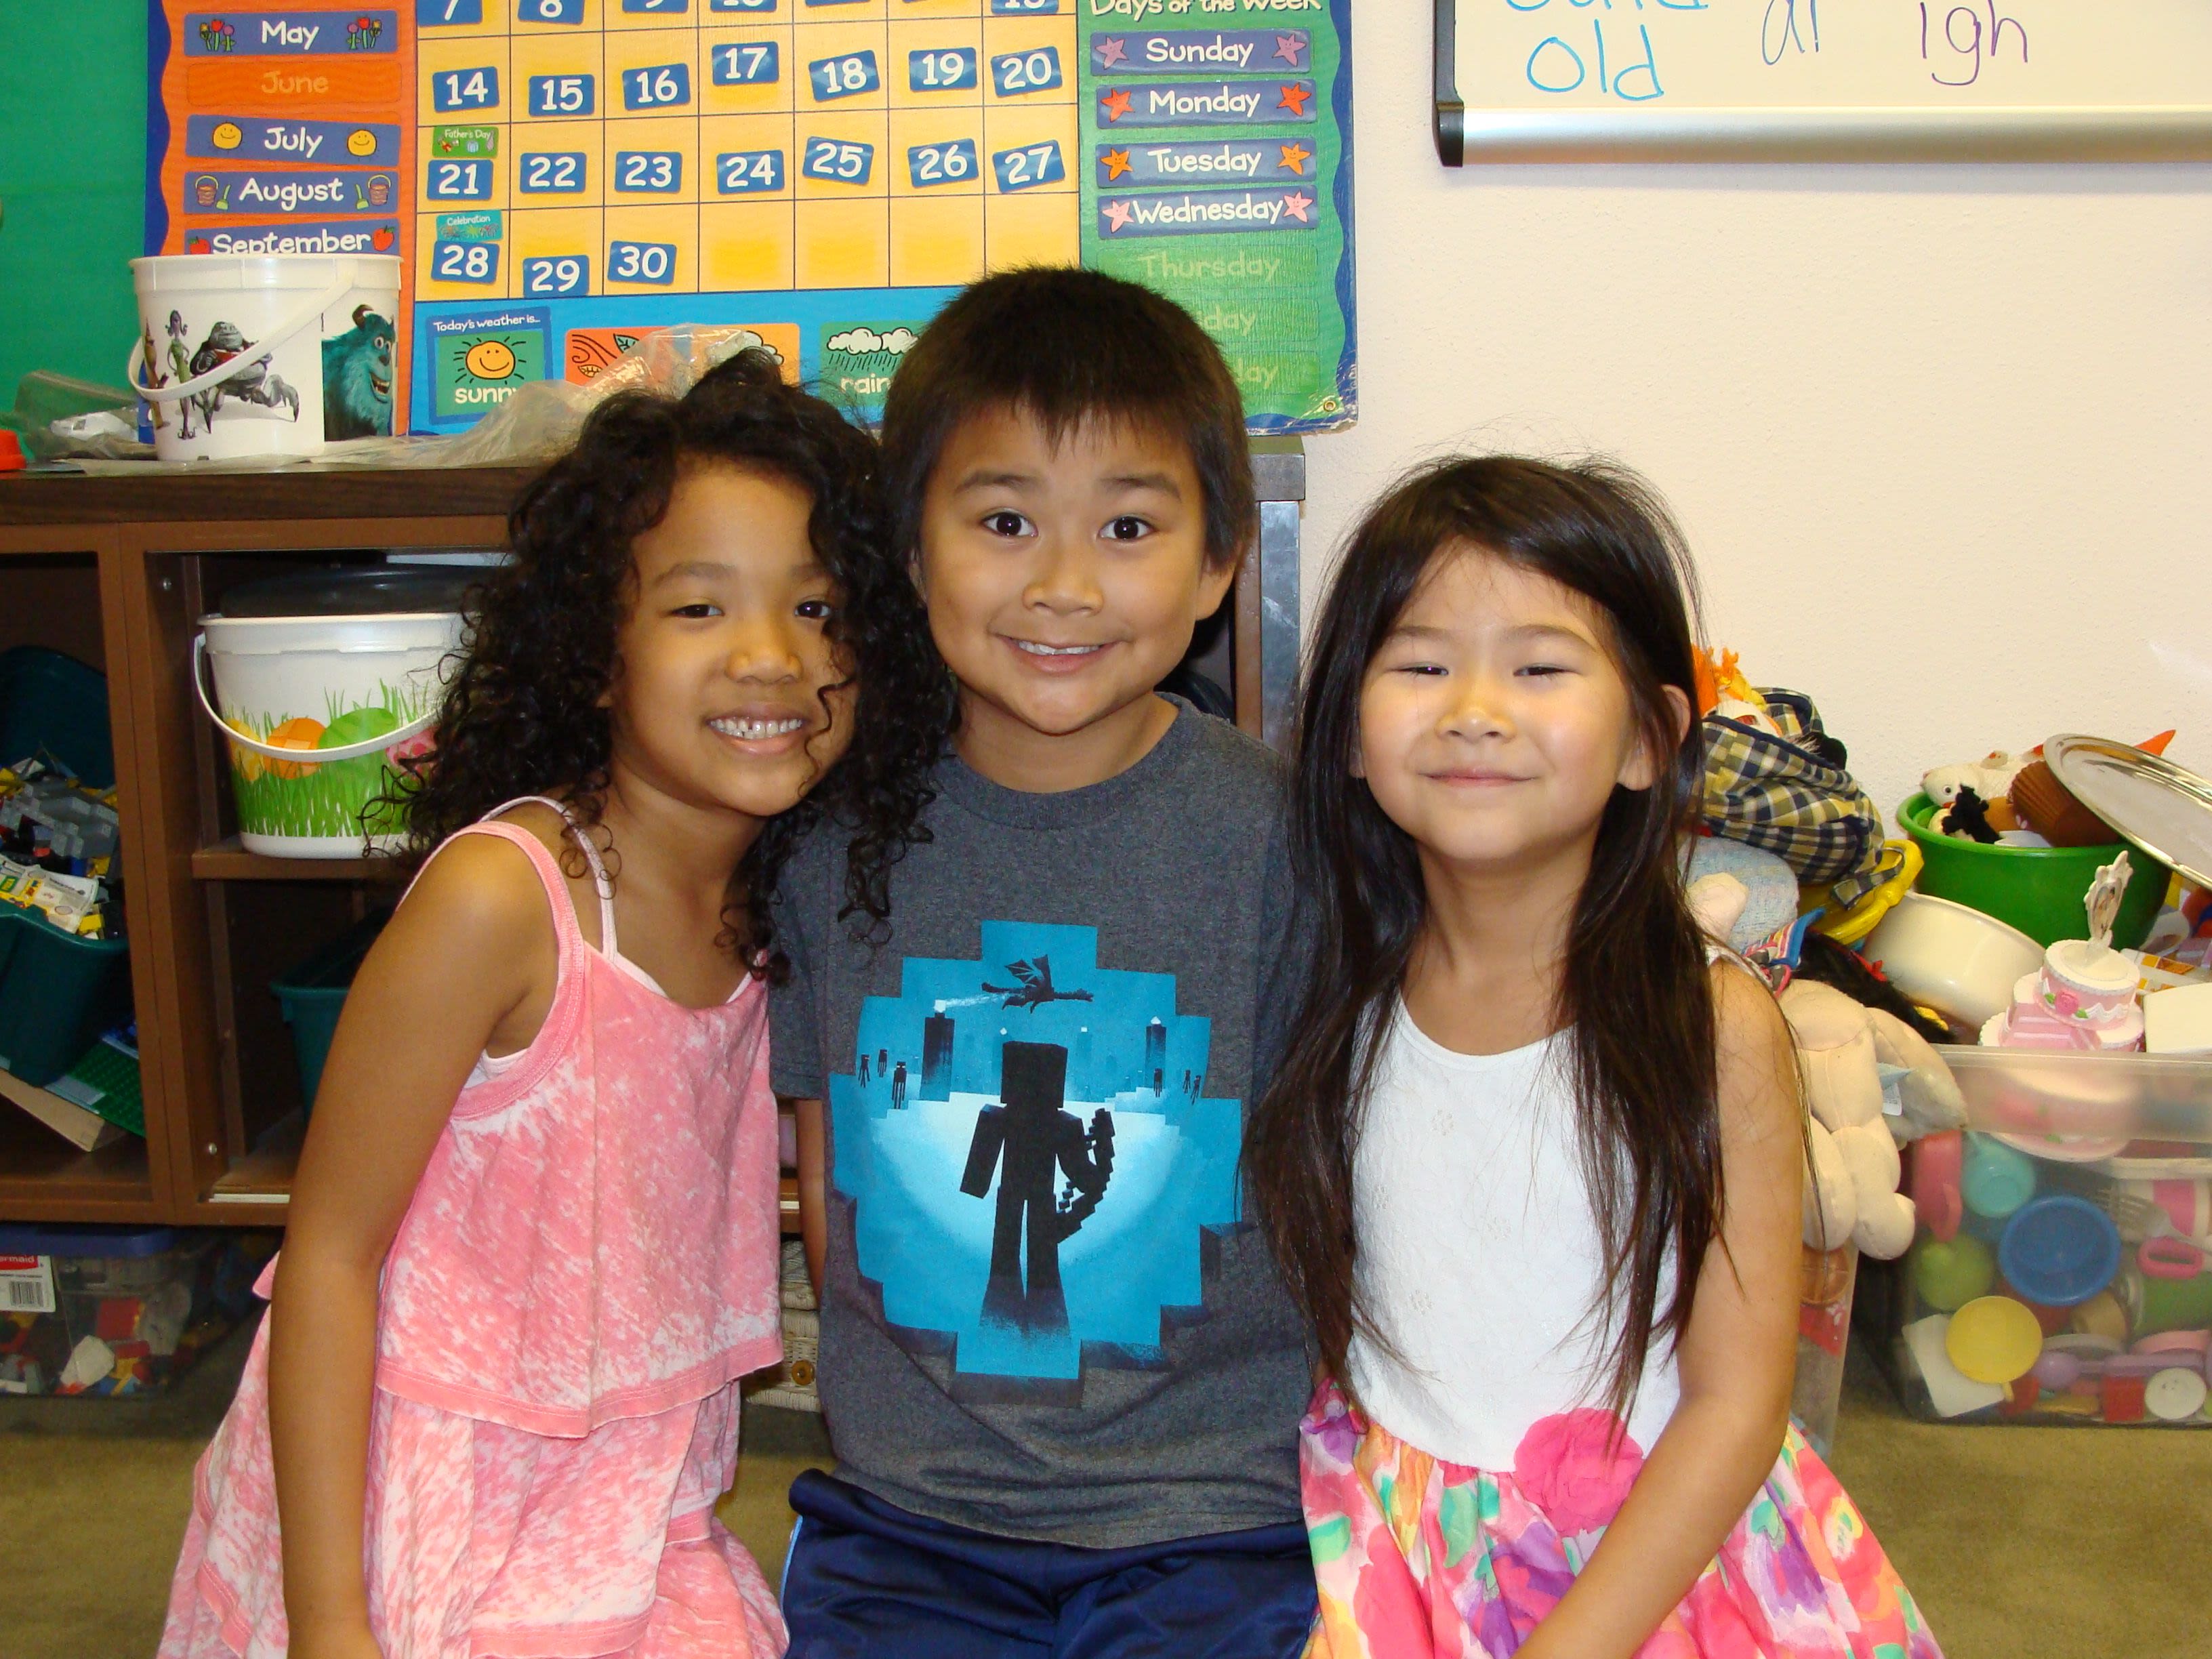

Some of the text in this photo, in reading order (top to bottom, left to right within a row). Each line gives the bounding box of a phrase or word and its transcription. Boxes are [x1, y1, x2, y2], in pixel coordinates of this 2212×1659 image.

[262, 20, 319, 50] May
[1146, 35, 1254, 67] Sunday
[725, 47, 768, 79] 17
[823, 58, 867, 94] 18
[922, 52, 964, 85] 19
[1001, 52, 1052, 89] 20
[261, 70, 329, 94] June
[446, 72, 488, 106] 14
[541, 79, 583, 111] 15
[636, 69, 678, 104] 16
[1149, 85, 1261, 117] Monday
[264, 127, 323, 158] July
[445, 128, 491, 140] Father's Day
[529, 155, 576, 187] 22
[625, 155, 672, 188] 23
[726, 154, 775, 188] 24
[813, 142, 864, 178] 25
[918, 144, 968, 180] 26
[1005, 146, 1053, 184] 27
[1147, 144, 1261, 176] Tuesday
[239, 178, 344, 211] August
[438, 163, 479, 194] 21
[447, 215, 491, 226] Celebration
[1132, 193, 1284, 224] Wednesday
[213, 228, 371, 253] September
[441, 245, 489, 278] 28
[531, 260, 580, 292] 29
[617, 246, 668, 279] 30
[1137, 251, 1281, 281] Thursday
[433, 319, 475, 332] Today's
[476, 314, 525, 328] weather
[1195, 305, 1256, 335] iday
[455, 387, 517, 404] sunn
[841, 373, 892, 394] rain
